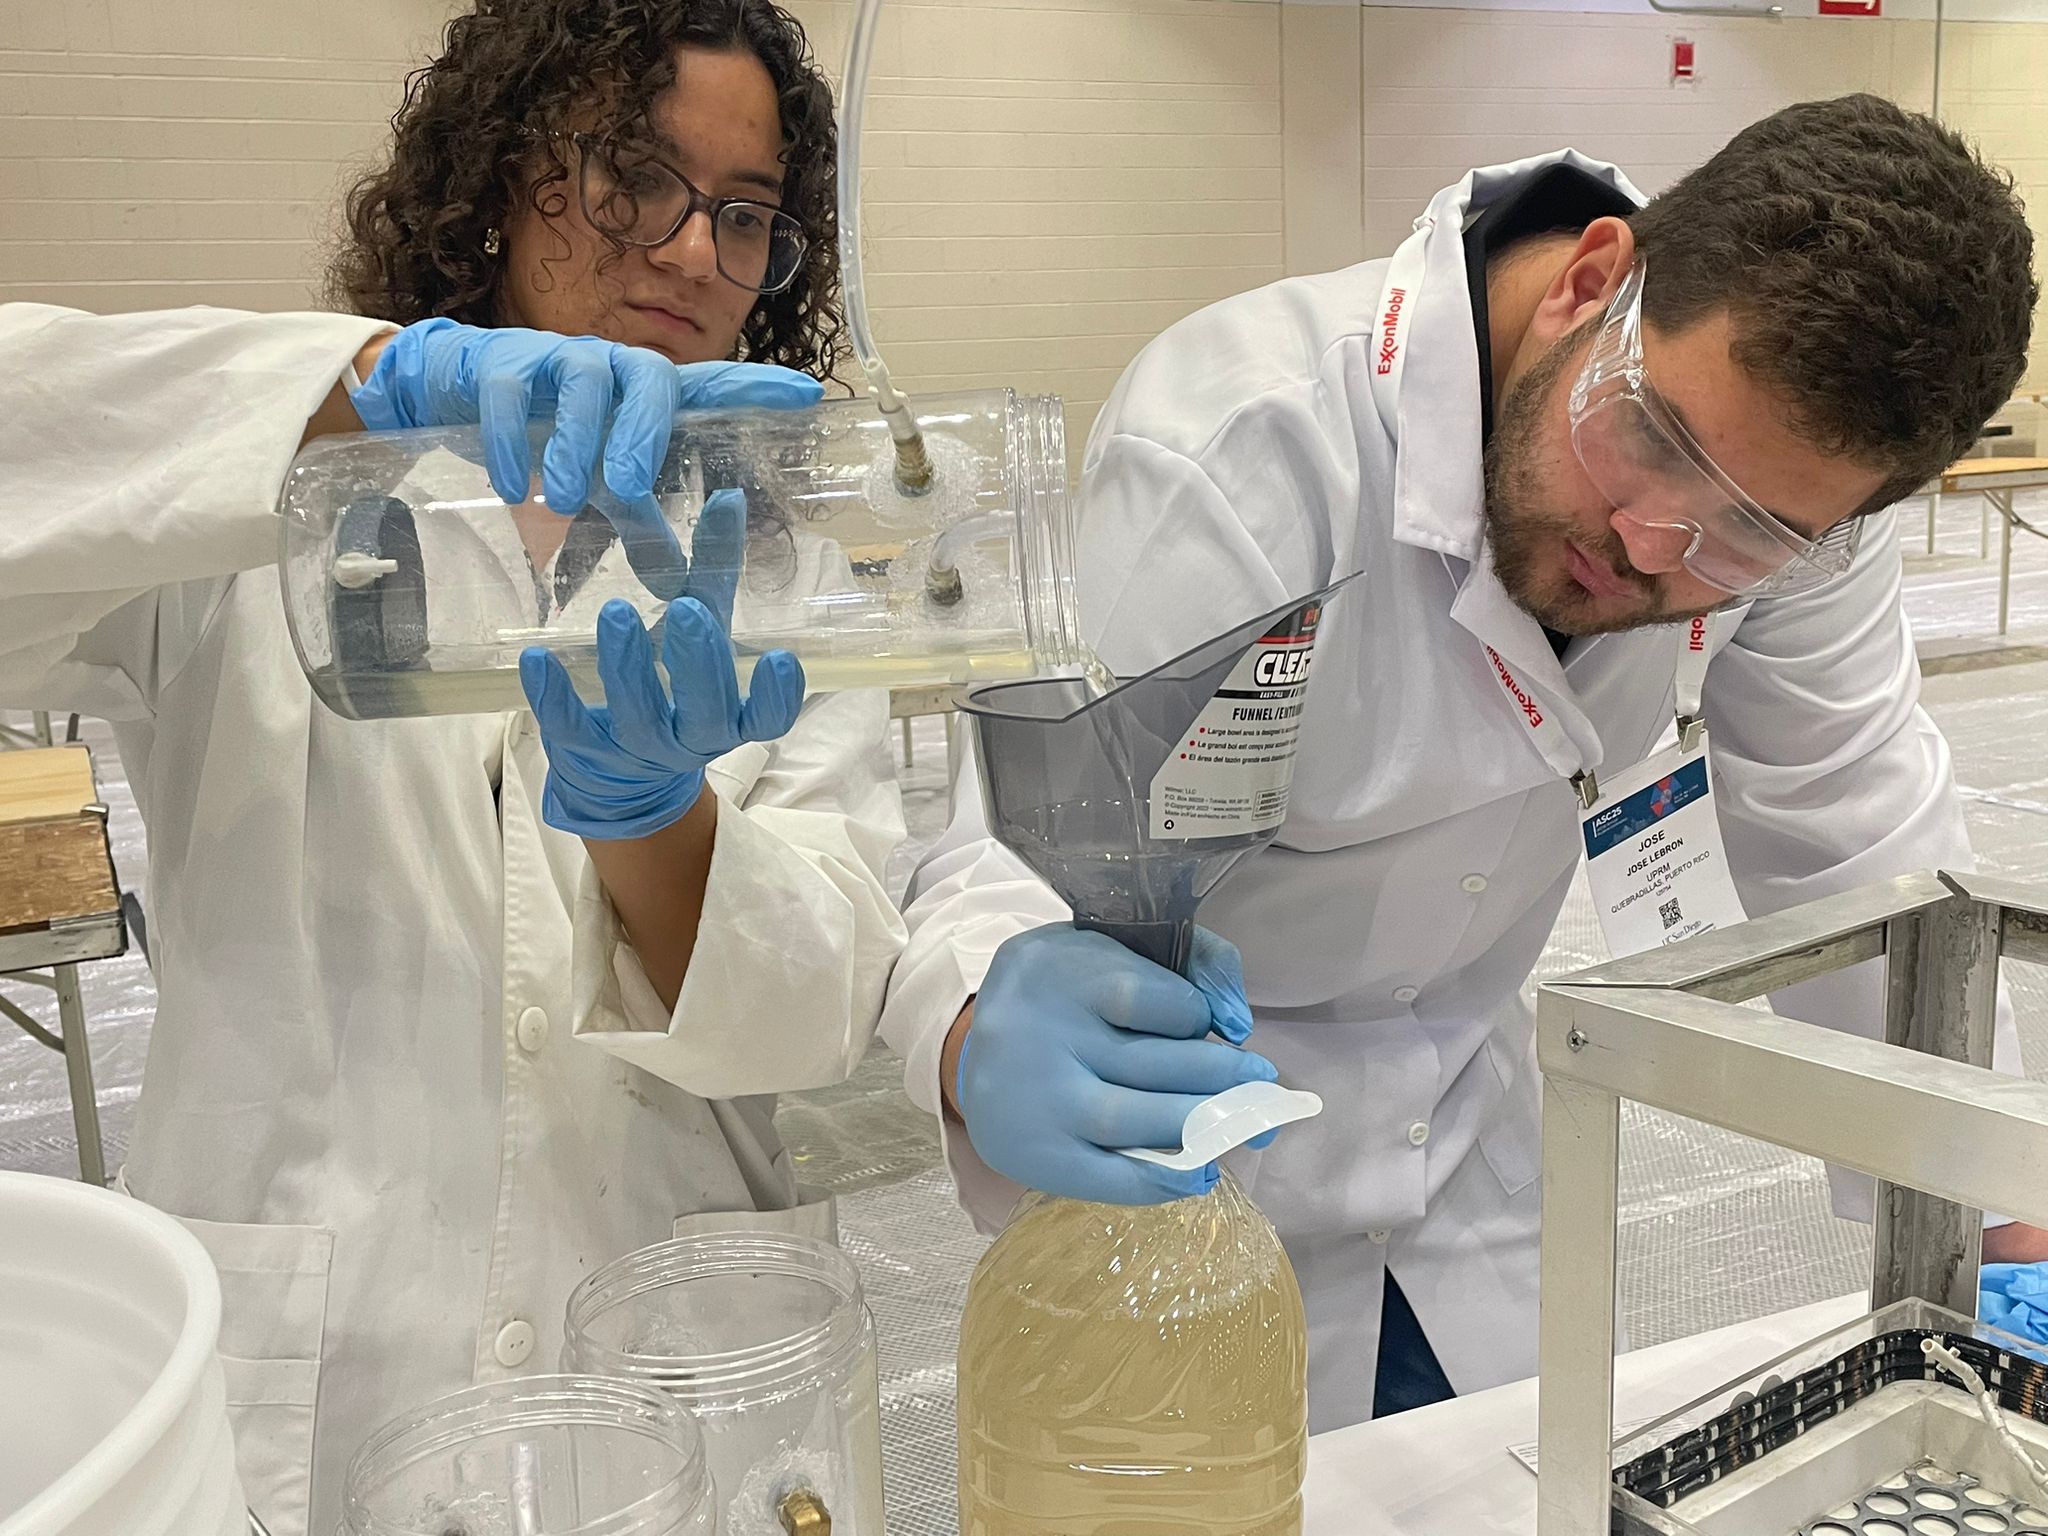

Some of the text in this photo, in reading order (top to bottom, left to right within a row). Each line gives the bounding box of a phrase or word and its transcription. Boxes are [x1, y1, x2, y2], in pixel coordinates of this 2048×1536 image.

[1207, 728, 1226, 736] Large
[1227, 742, 1237, 750] bol
[1242, 757, 1260, 765] grande
[1170, 802, 1196, 810] Copyright
[1596, 806, 1622, 827] ASC25
[1638, 830, 1666, 852] JOSE
[1627, 838, 1684, 877] JOSE LEBRON
[1665, 861, 1692, 881] PUERTO
[1693, 850, 1710, 865] RICO
[1646, 862, 1671, 882] UPRM
